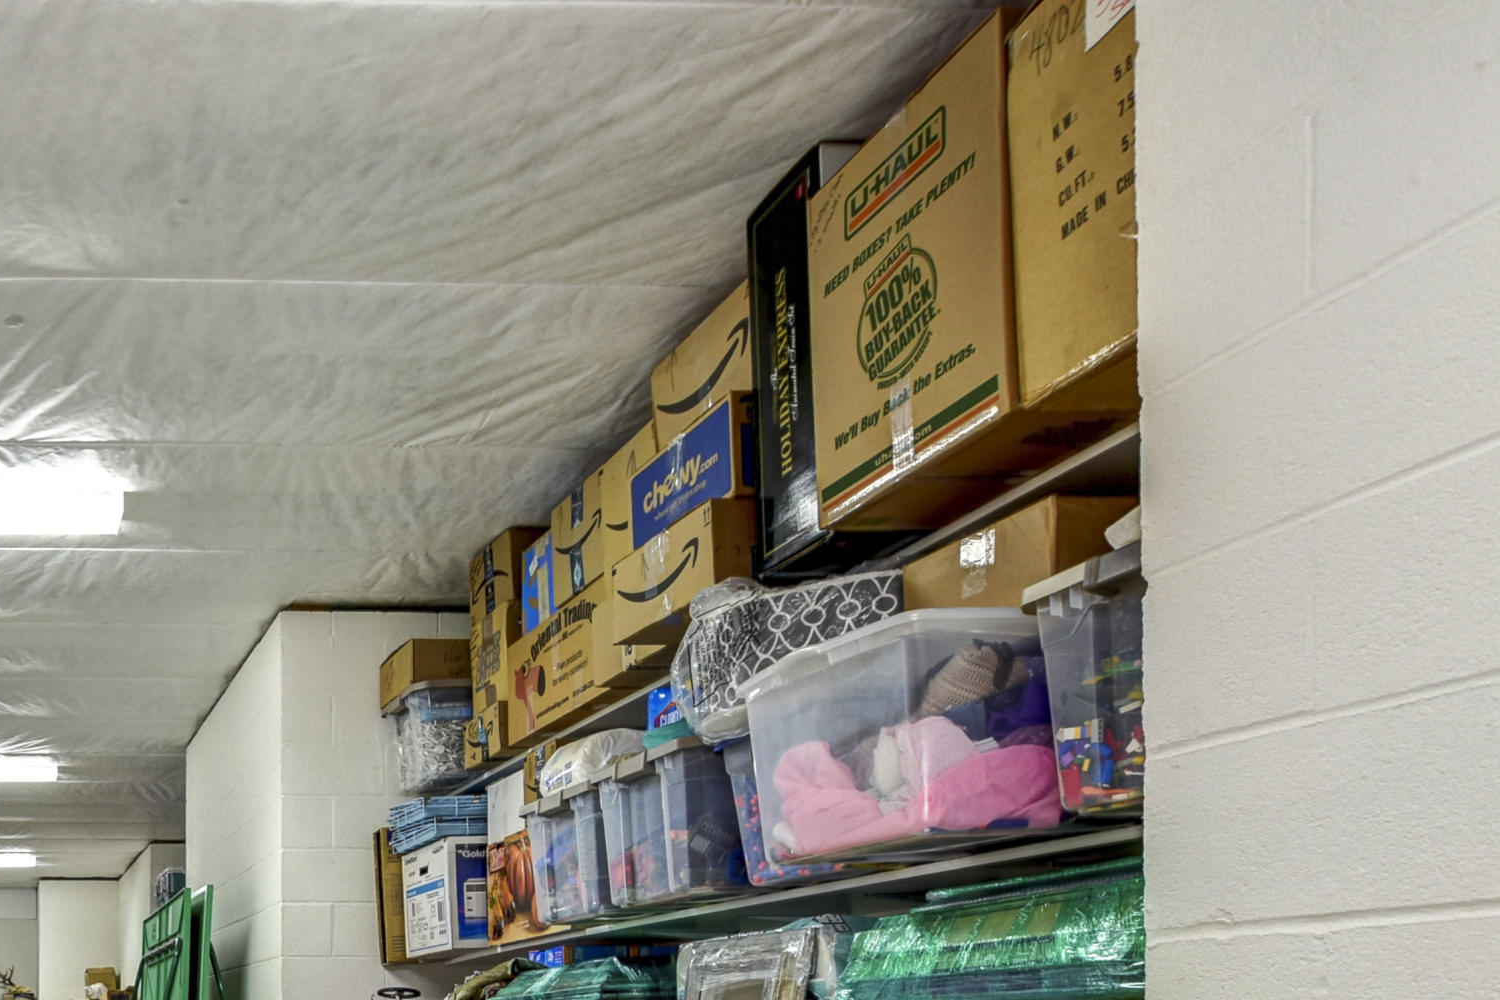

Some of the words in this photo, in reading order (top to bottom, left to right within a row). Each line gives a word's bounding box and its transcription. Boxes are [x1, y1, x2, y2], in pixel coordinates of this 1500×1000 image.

[851, 124, 940, 218] U-HAUL
[1061, 205, 1089, 241] MADE
[1094, 190, 1107, 213] IN
[823, 265, 850, 299] NEED
[851, 226, 893, 274] BOXES?
[895, 198, 924, 235] TAKE
[925, 150, 977, 209] PLENTY!
[866, 240, 910, 290] U-HAUL
[774, 265, 789, 369] EXPRESS
[865, 256, 921, 333] 100%
[865, 278, 933, 364] BUY-BACK
[777, 374, 793, 478] HOLIDAY
[834, 424, 858, 451] We'll
[860, 409, 881, 433] Buy
[883, 387, 910, 419] Back
[913, 373, 932, 396] the
[934, 342, 977, 381] Extras.
